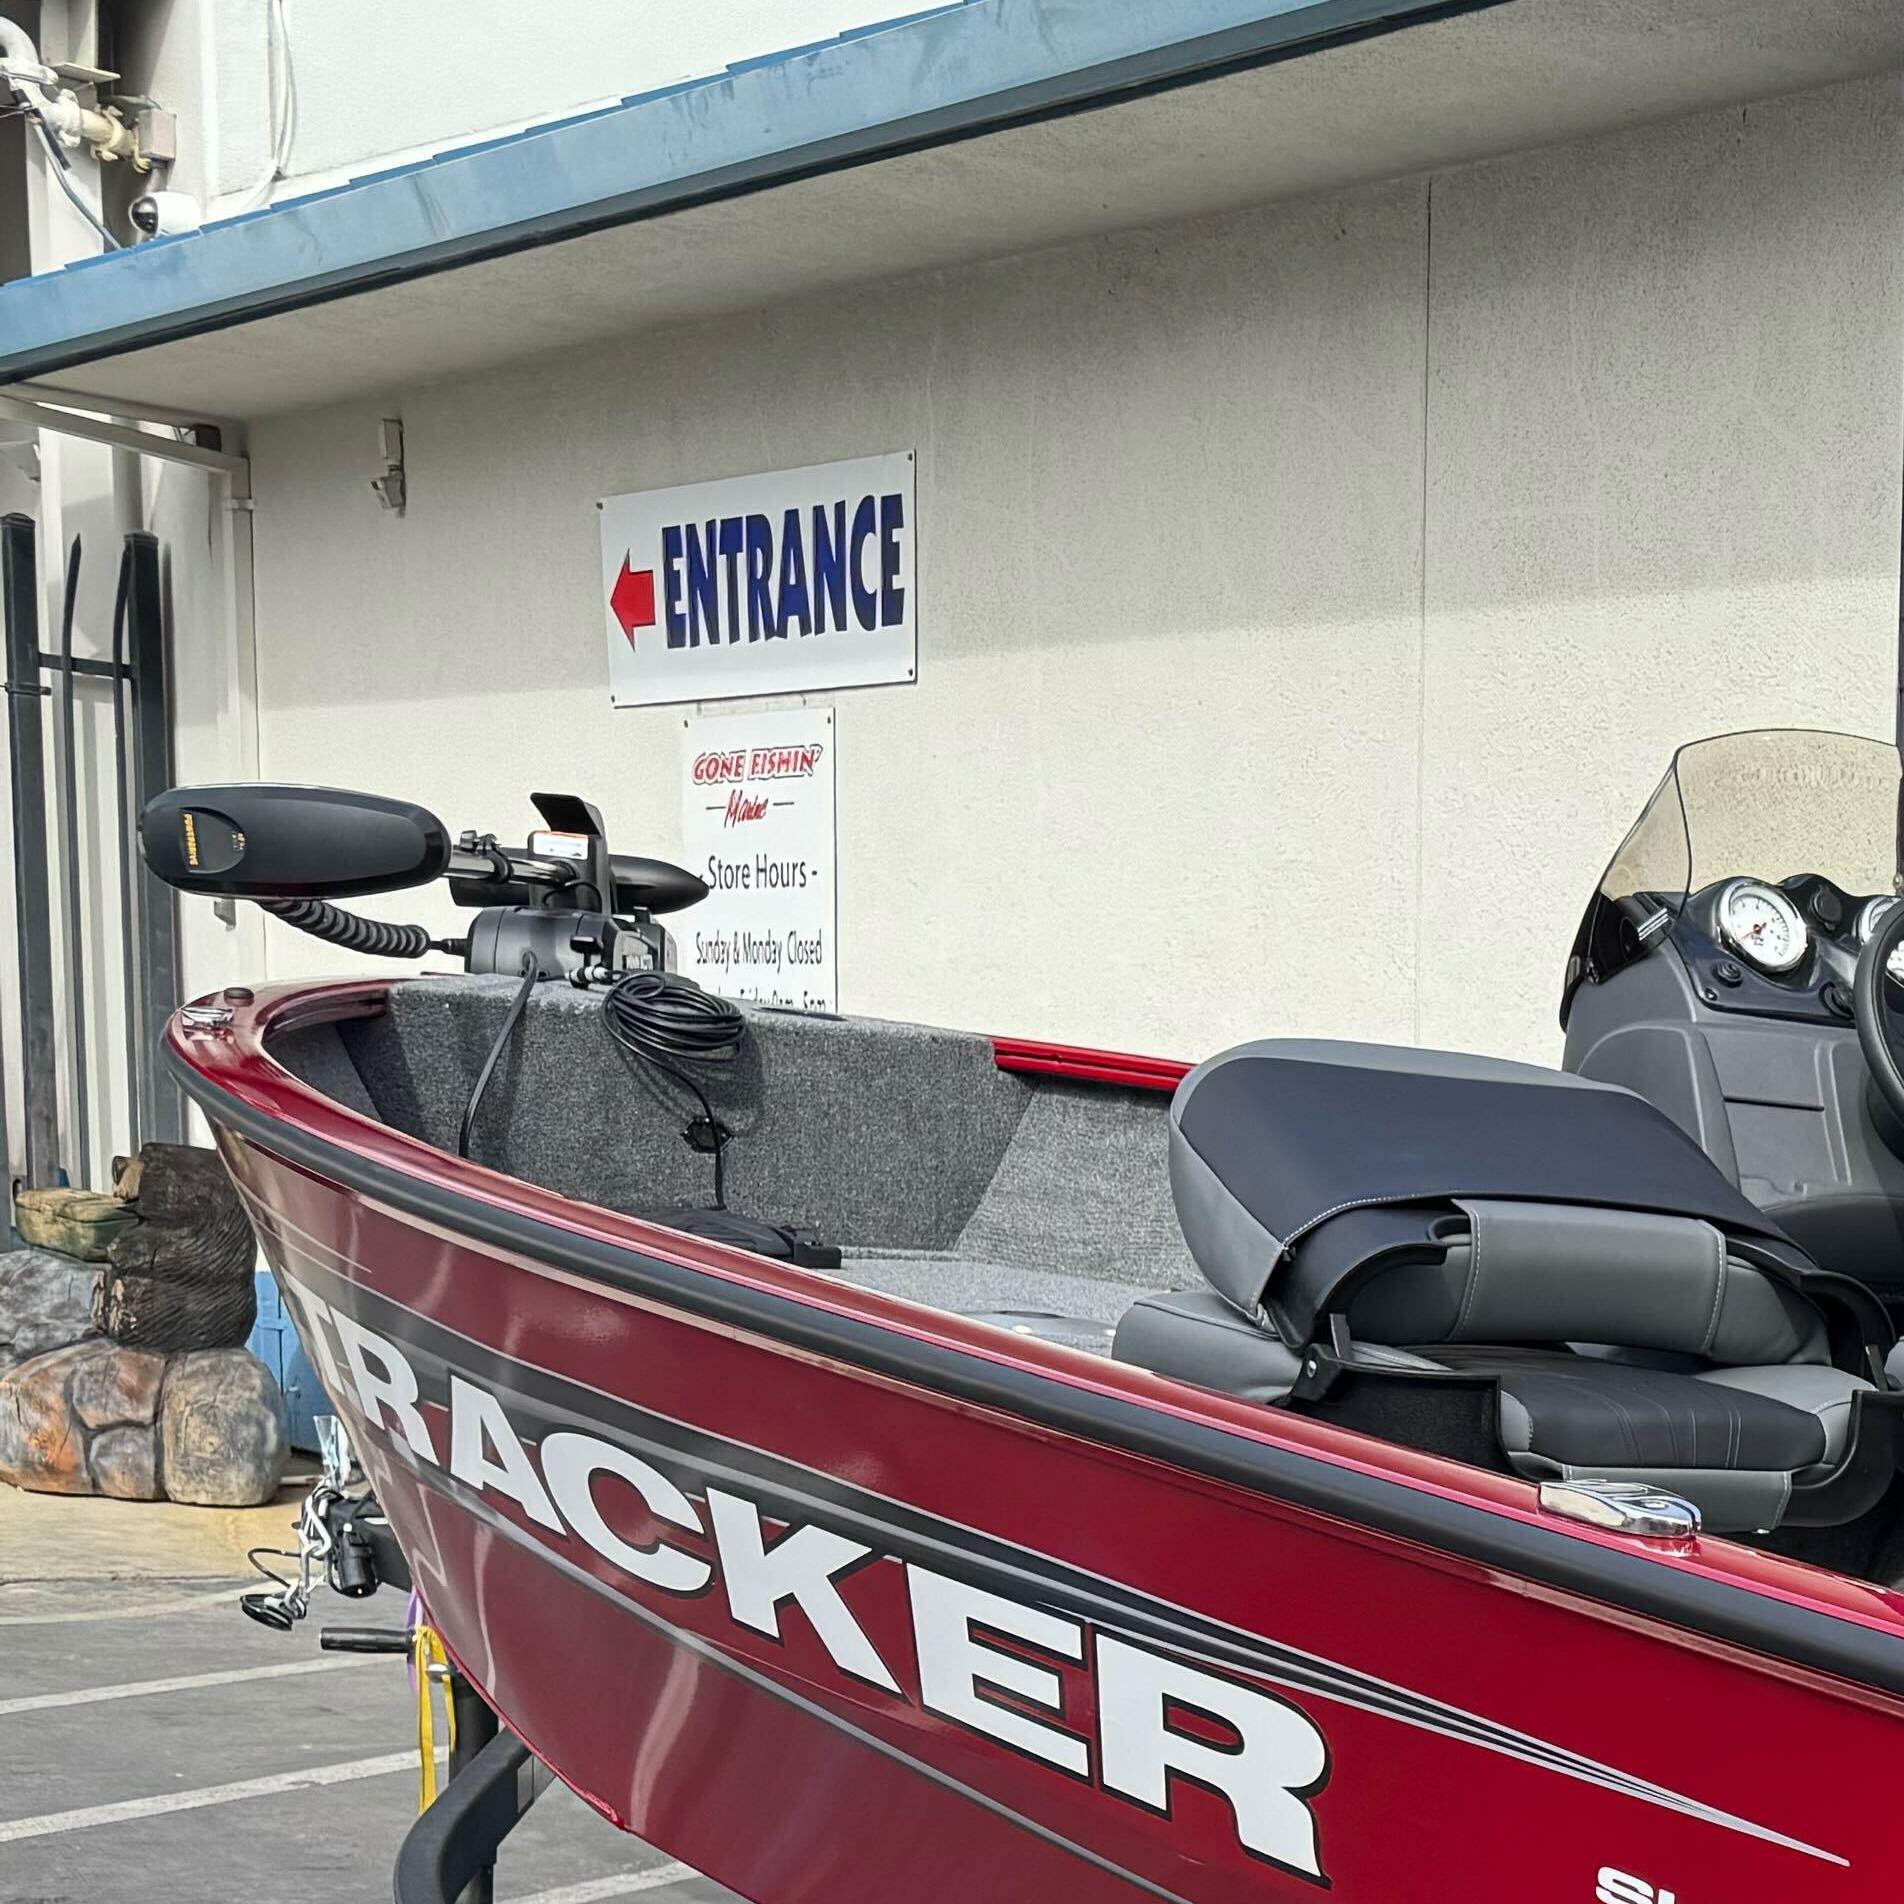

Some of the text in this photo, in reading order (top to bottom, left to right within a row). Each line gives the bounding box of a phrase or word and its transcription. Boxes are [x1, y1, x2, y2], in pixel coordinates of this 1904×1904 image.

[661, 494, 905, 651] ENTRANCE
[692, 750, 747, 785] GONE
[708, 853, 807, 890] Store Hours
[696, 929, 731, 974] Sunday
[742, 928, 783, 974] Monday
[787, 928, 823, 965] Closed
[286, 1268, 1330, 1888] TRACKER
